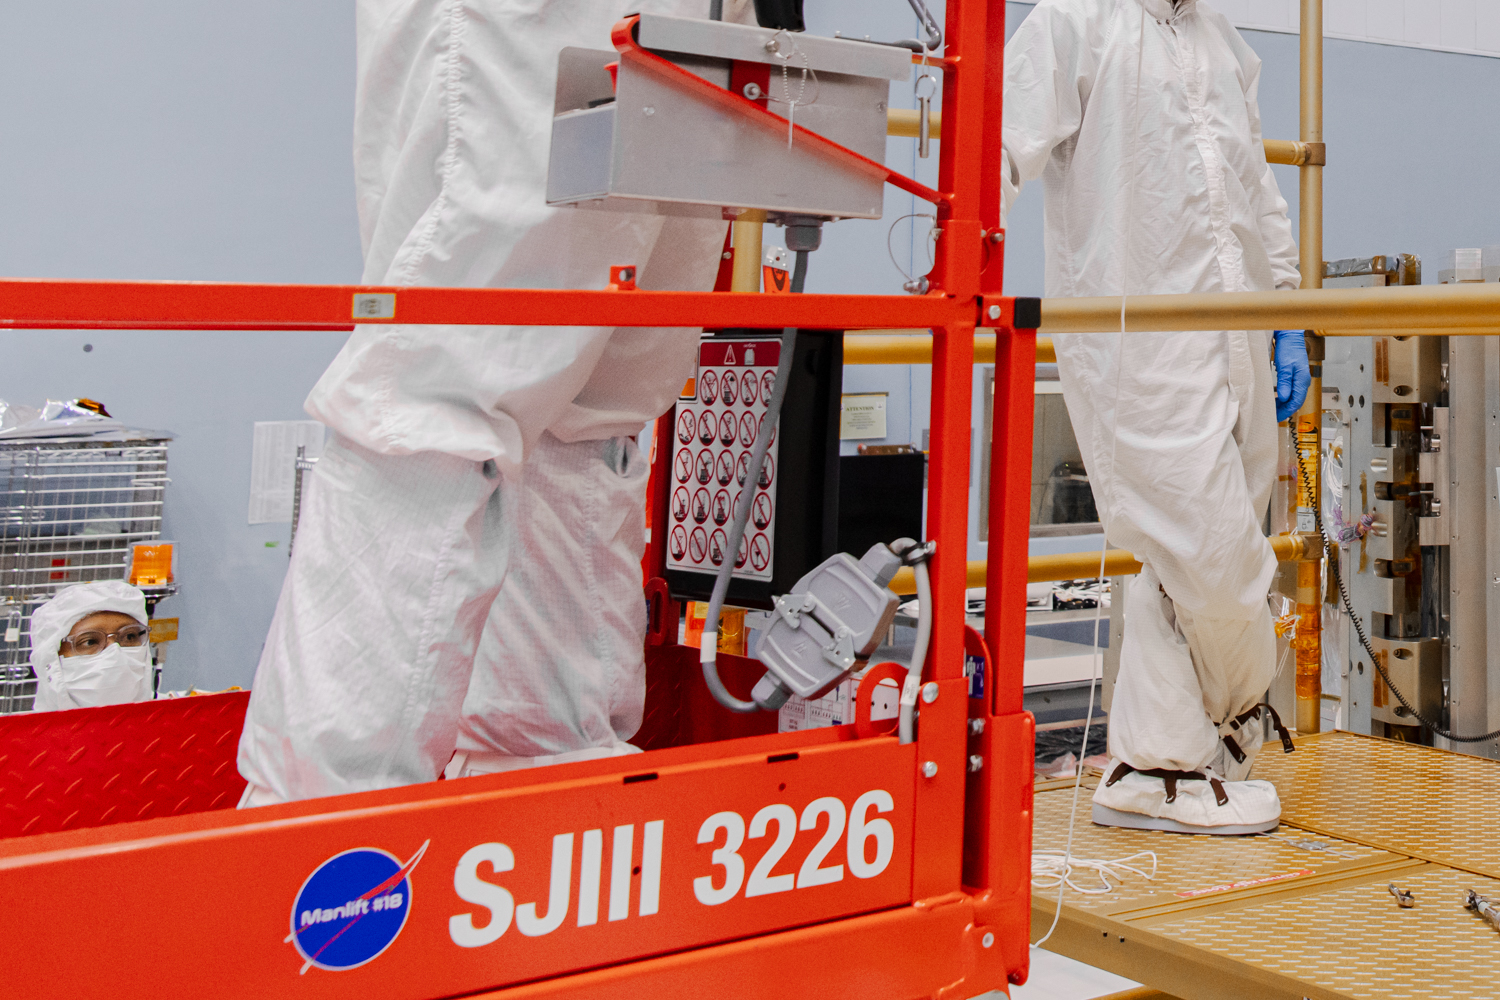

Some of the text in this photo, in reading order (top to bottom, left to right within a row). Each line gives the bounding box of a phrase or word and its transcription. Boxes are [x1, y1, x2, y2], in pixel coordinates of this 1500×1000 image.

[300, 893, 404, 927] Manlift #18
[448, 788, 895, 949] SJIII 3226
